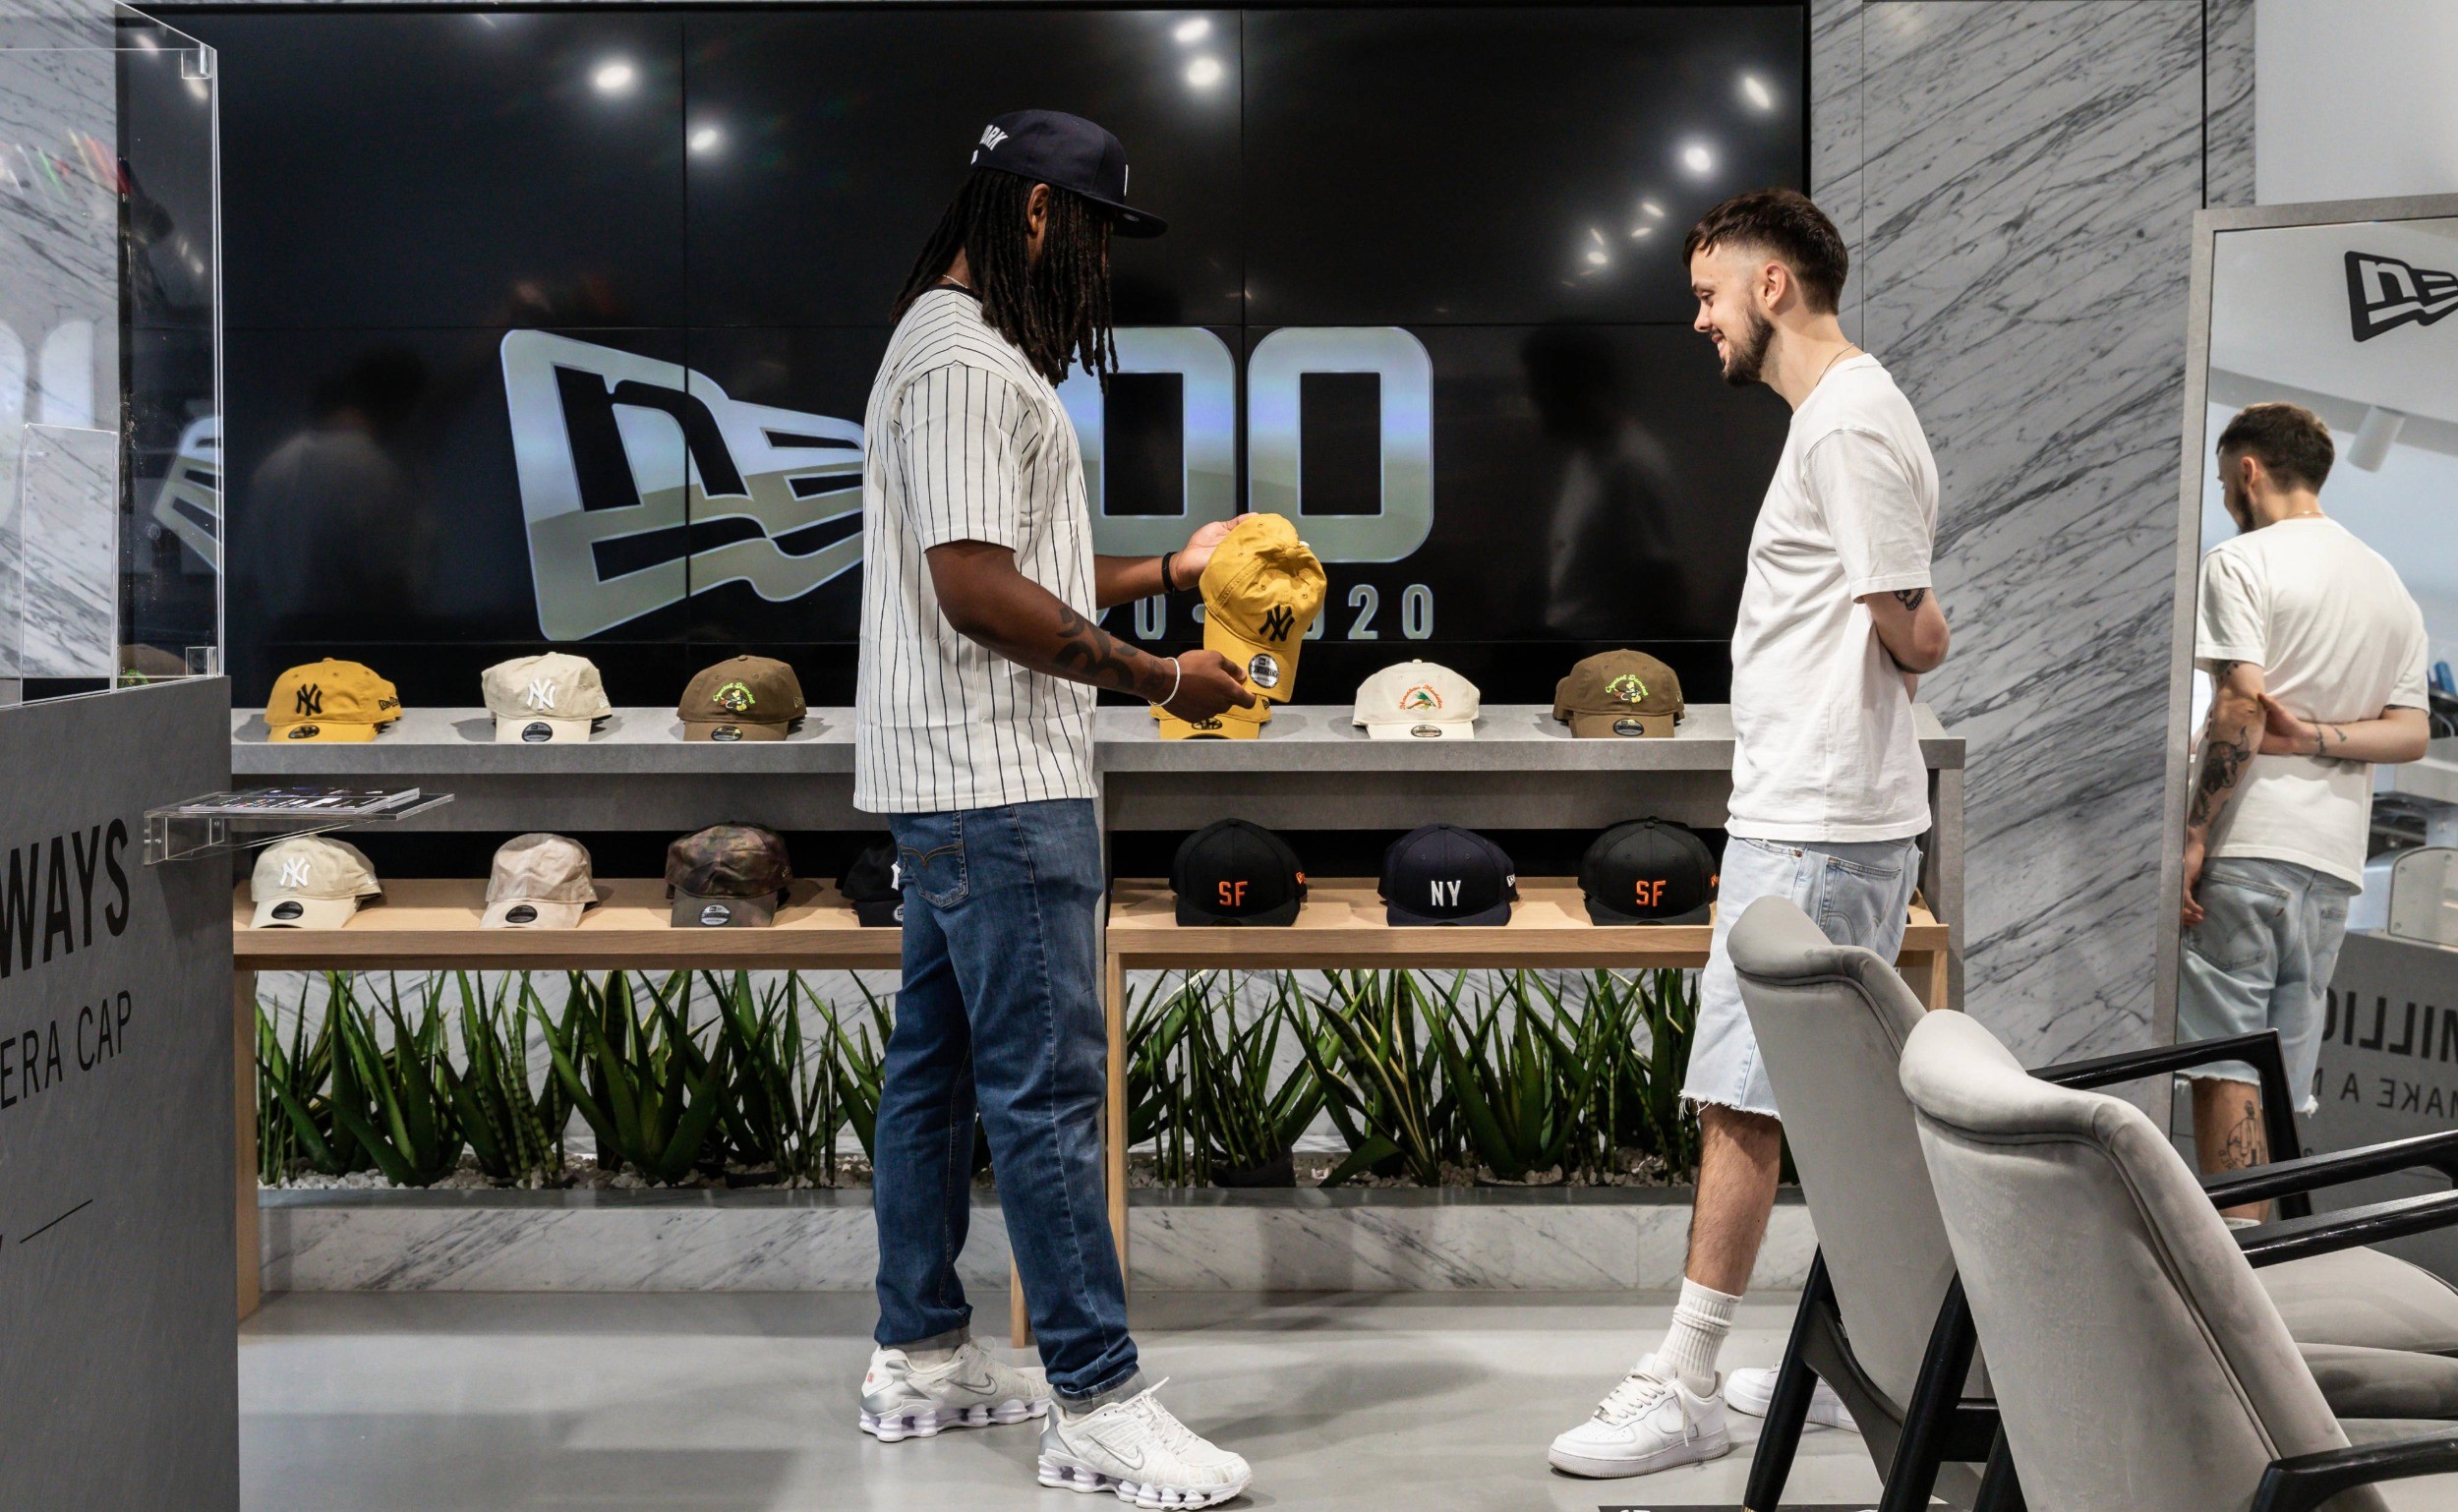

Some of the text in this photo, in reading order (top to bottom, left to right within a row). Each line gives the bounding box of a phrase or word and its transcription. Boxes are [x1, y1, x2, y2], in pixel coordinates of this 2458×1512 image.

[1258, 603, 1296, 642] NY
[296, 682, 323, 717] NY
[526, 677, 556, 710] NY
[279, 856, 311, 888] NY
[0, 818, 130, 979] WAYS
[1218, 880, 1249, 907] SF
[1431, 879, 1462, 907] NY
[1635, 879, 1667, 907] SF
[0, 989, 133, 1111] ERA CAP
